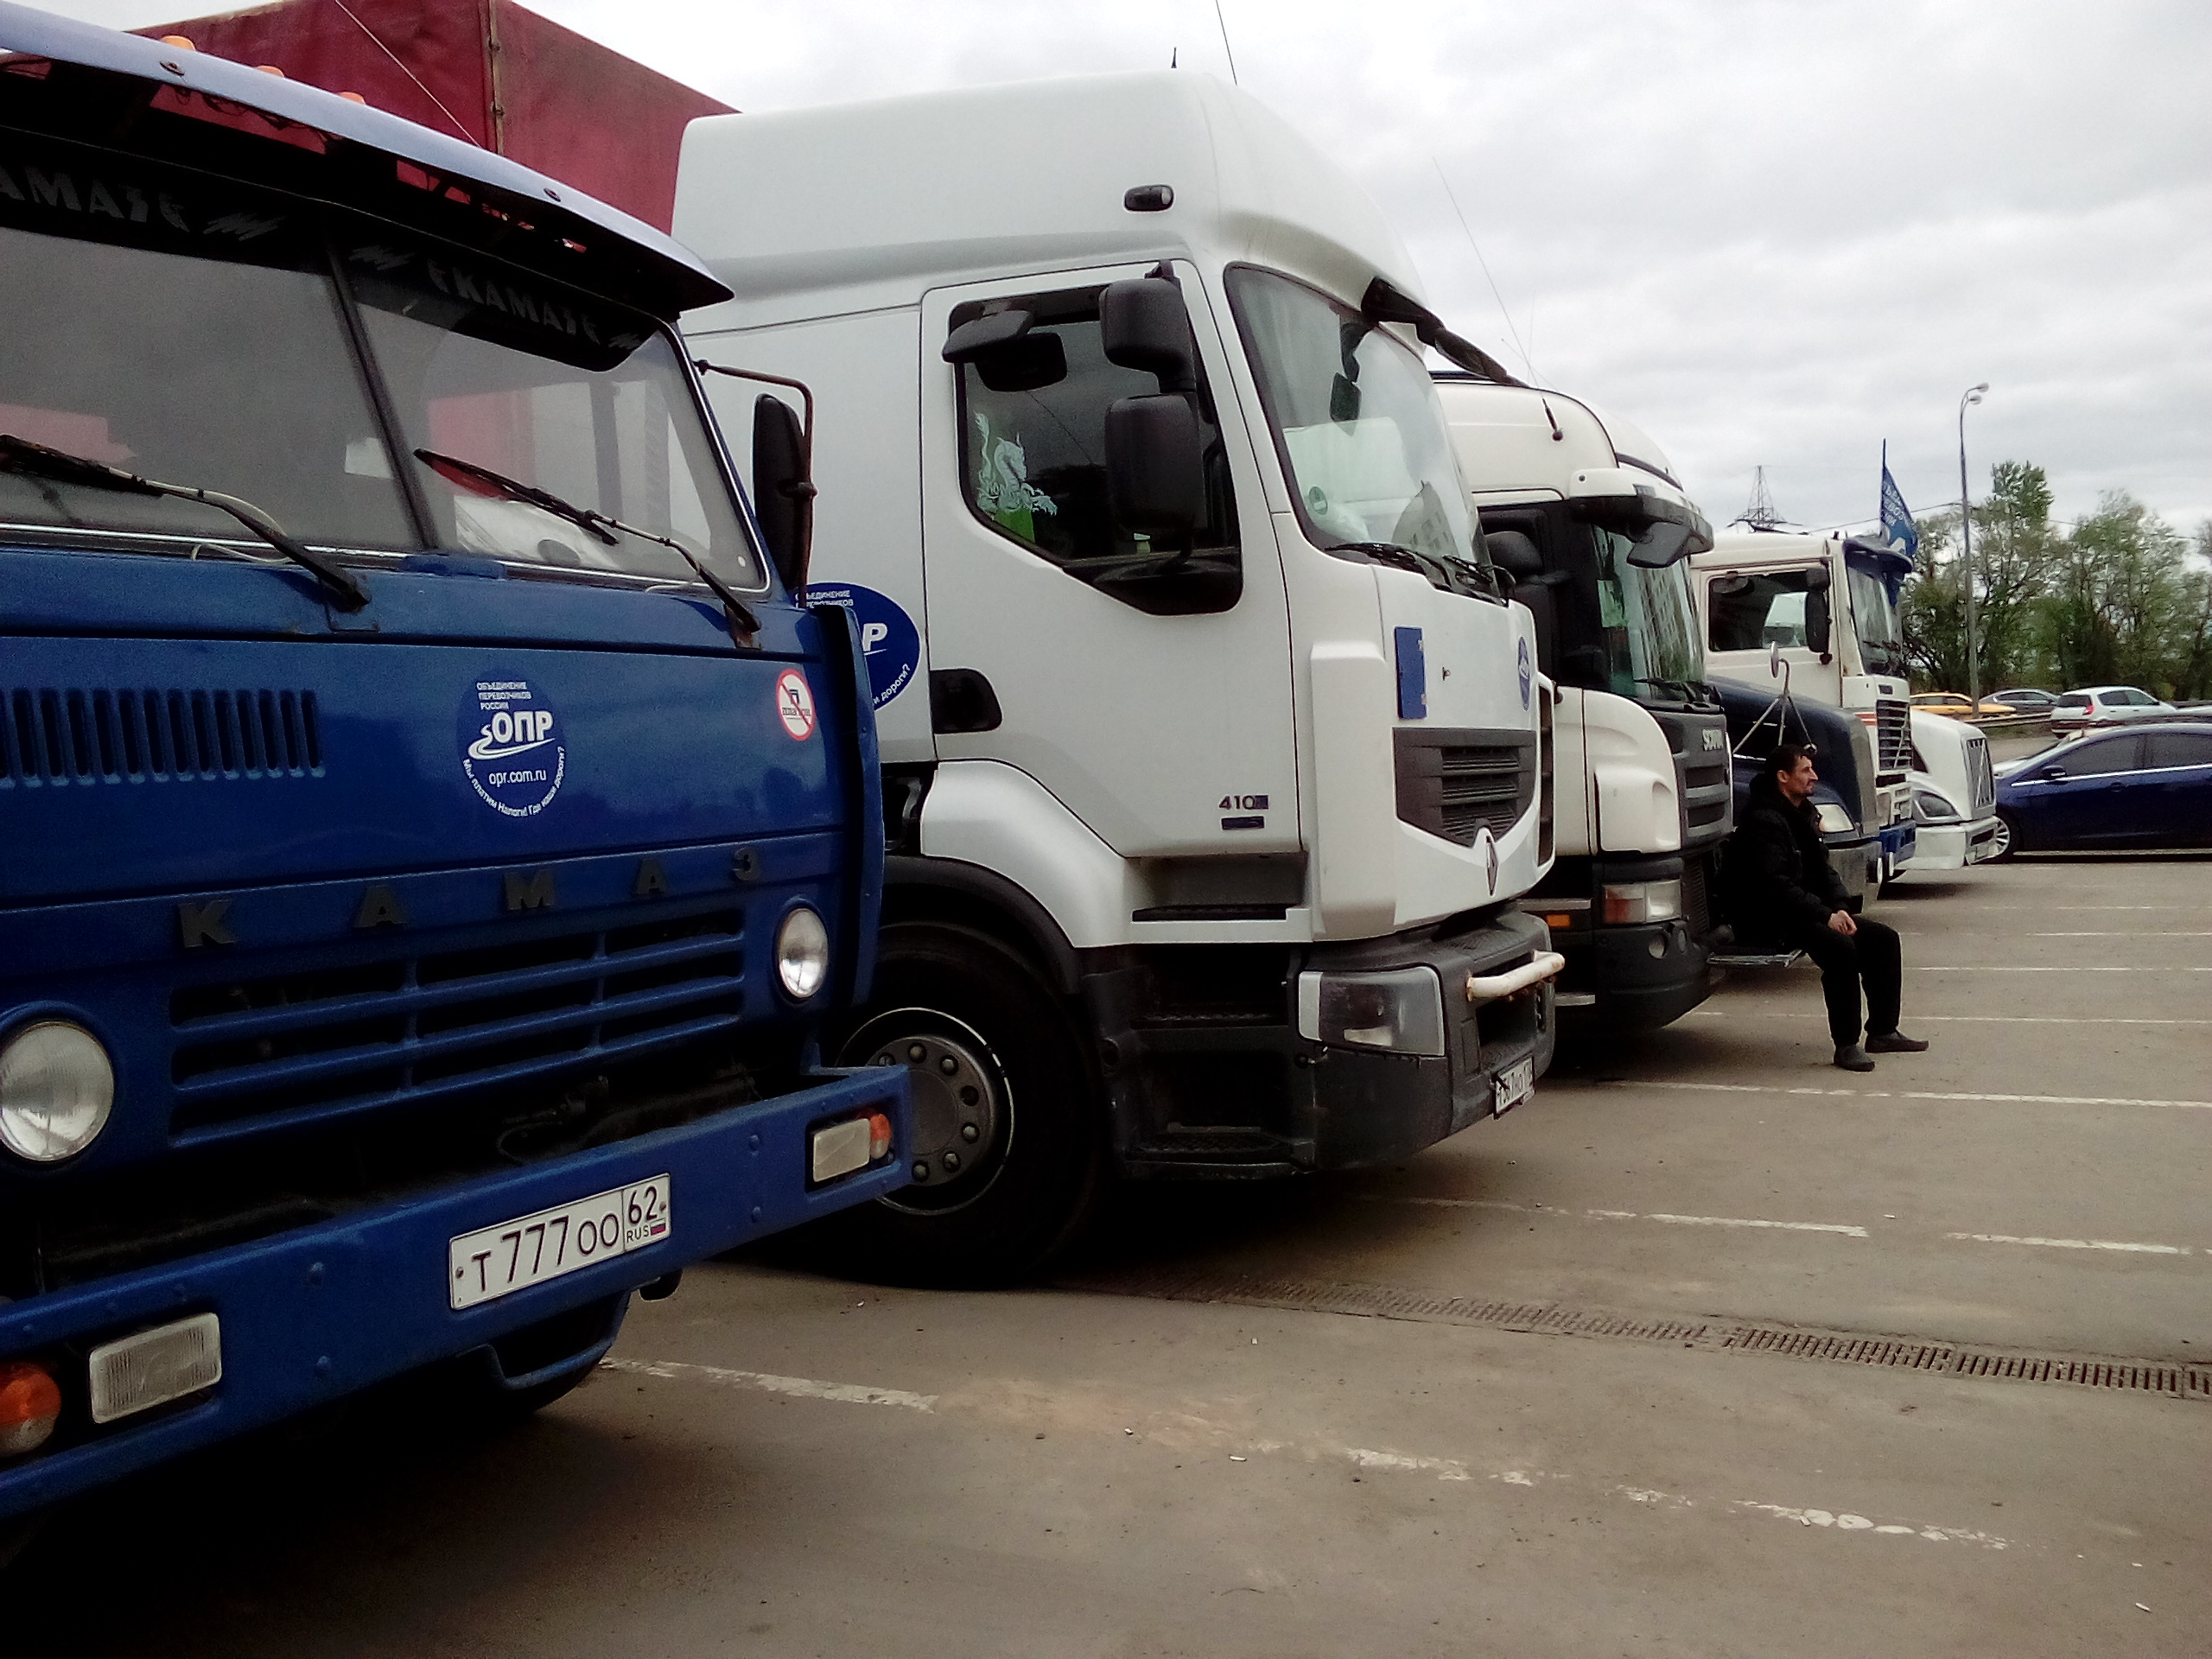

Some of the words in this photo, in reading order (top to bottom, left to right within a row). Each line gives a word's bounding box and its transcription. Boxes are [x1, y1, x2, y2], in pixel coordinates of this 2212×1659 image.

[492, 710, 554, 743] ОПР
[488, 769, 547, 787] opr.com.ru
[1218, 795, 1255, 810] 410
[179, 848, 761, 948] КАМАЗ
[628, 1185, 658, 1225] 62
[626, 1224, 650, 1243] RUS
